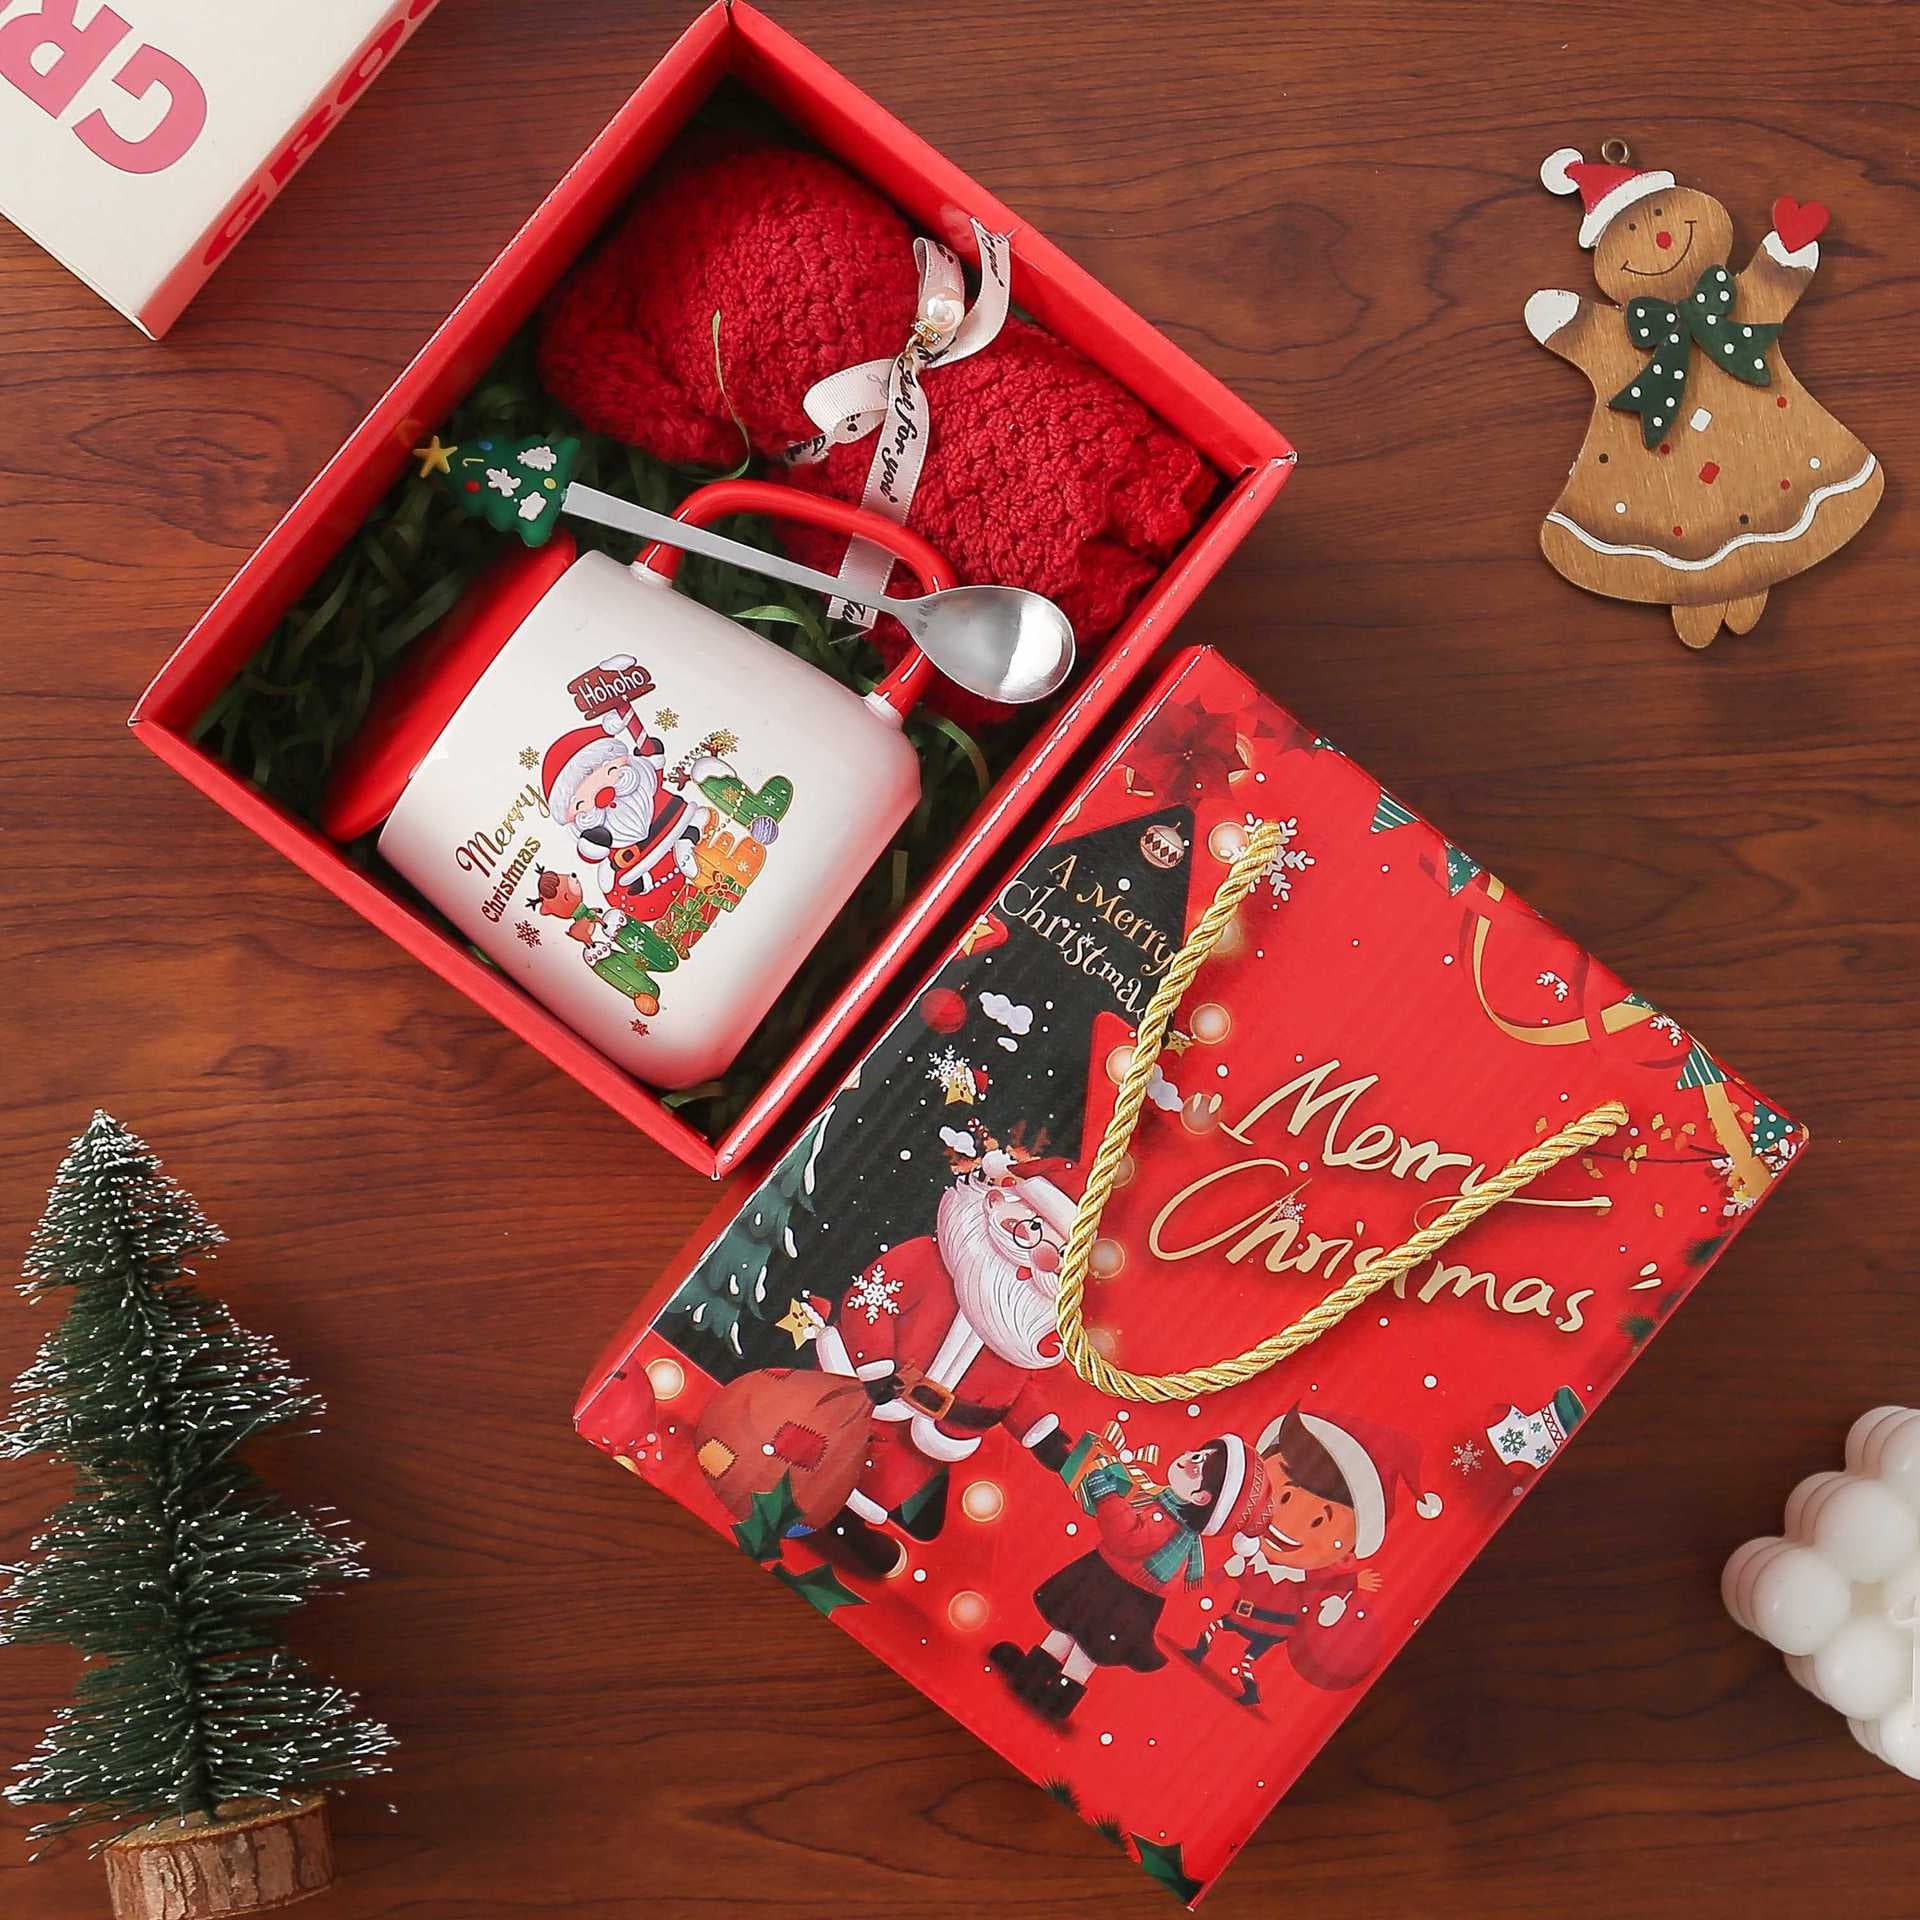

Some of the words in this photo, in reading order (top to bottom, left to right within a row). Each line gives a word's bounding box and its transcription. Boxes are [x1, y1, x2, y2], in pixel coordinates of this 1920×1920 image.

[0, 0, 207, 175] GR
[203, 0, 434, 266] GRO
[879, 446, 900, 499] you
[894, 397, 918, 455] for
[579, 670, 646, 711] Hohoho
[455, 783, 552, 879] Merry
[481, 836, 542, 925] Christmas
[1049, 854, 1078, 892] A
[1076, 881, 1177, 977] Merry
[998, 880, 1148, 1020] Christma
